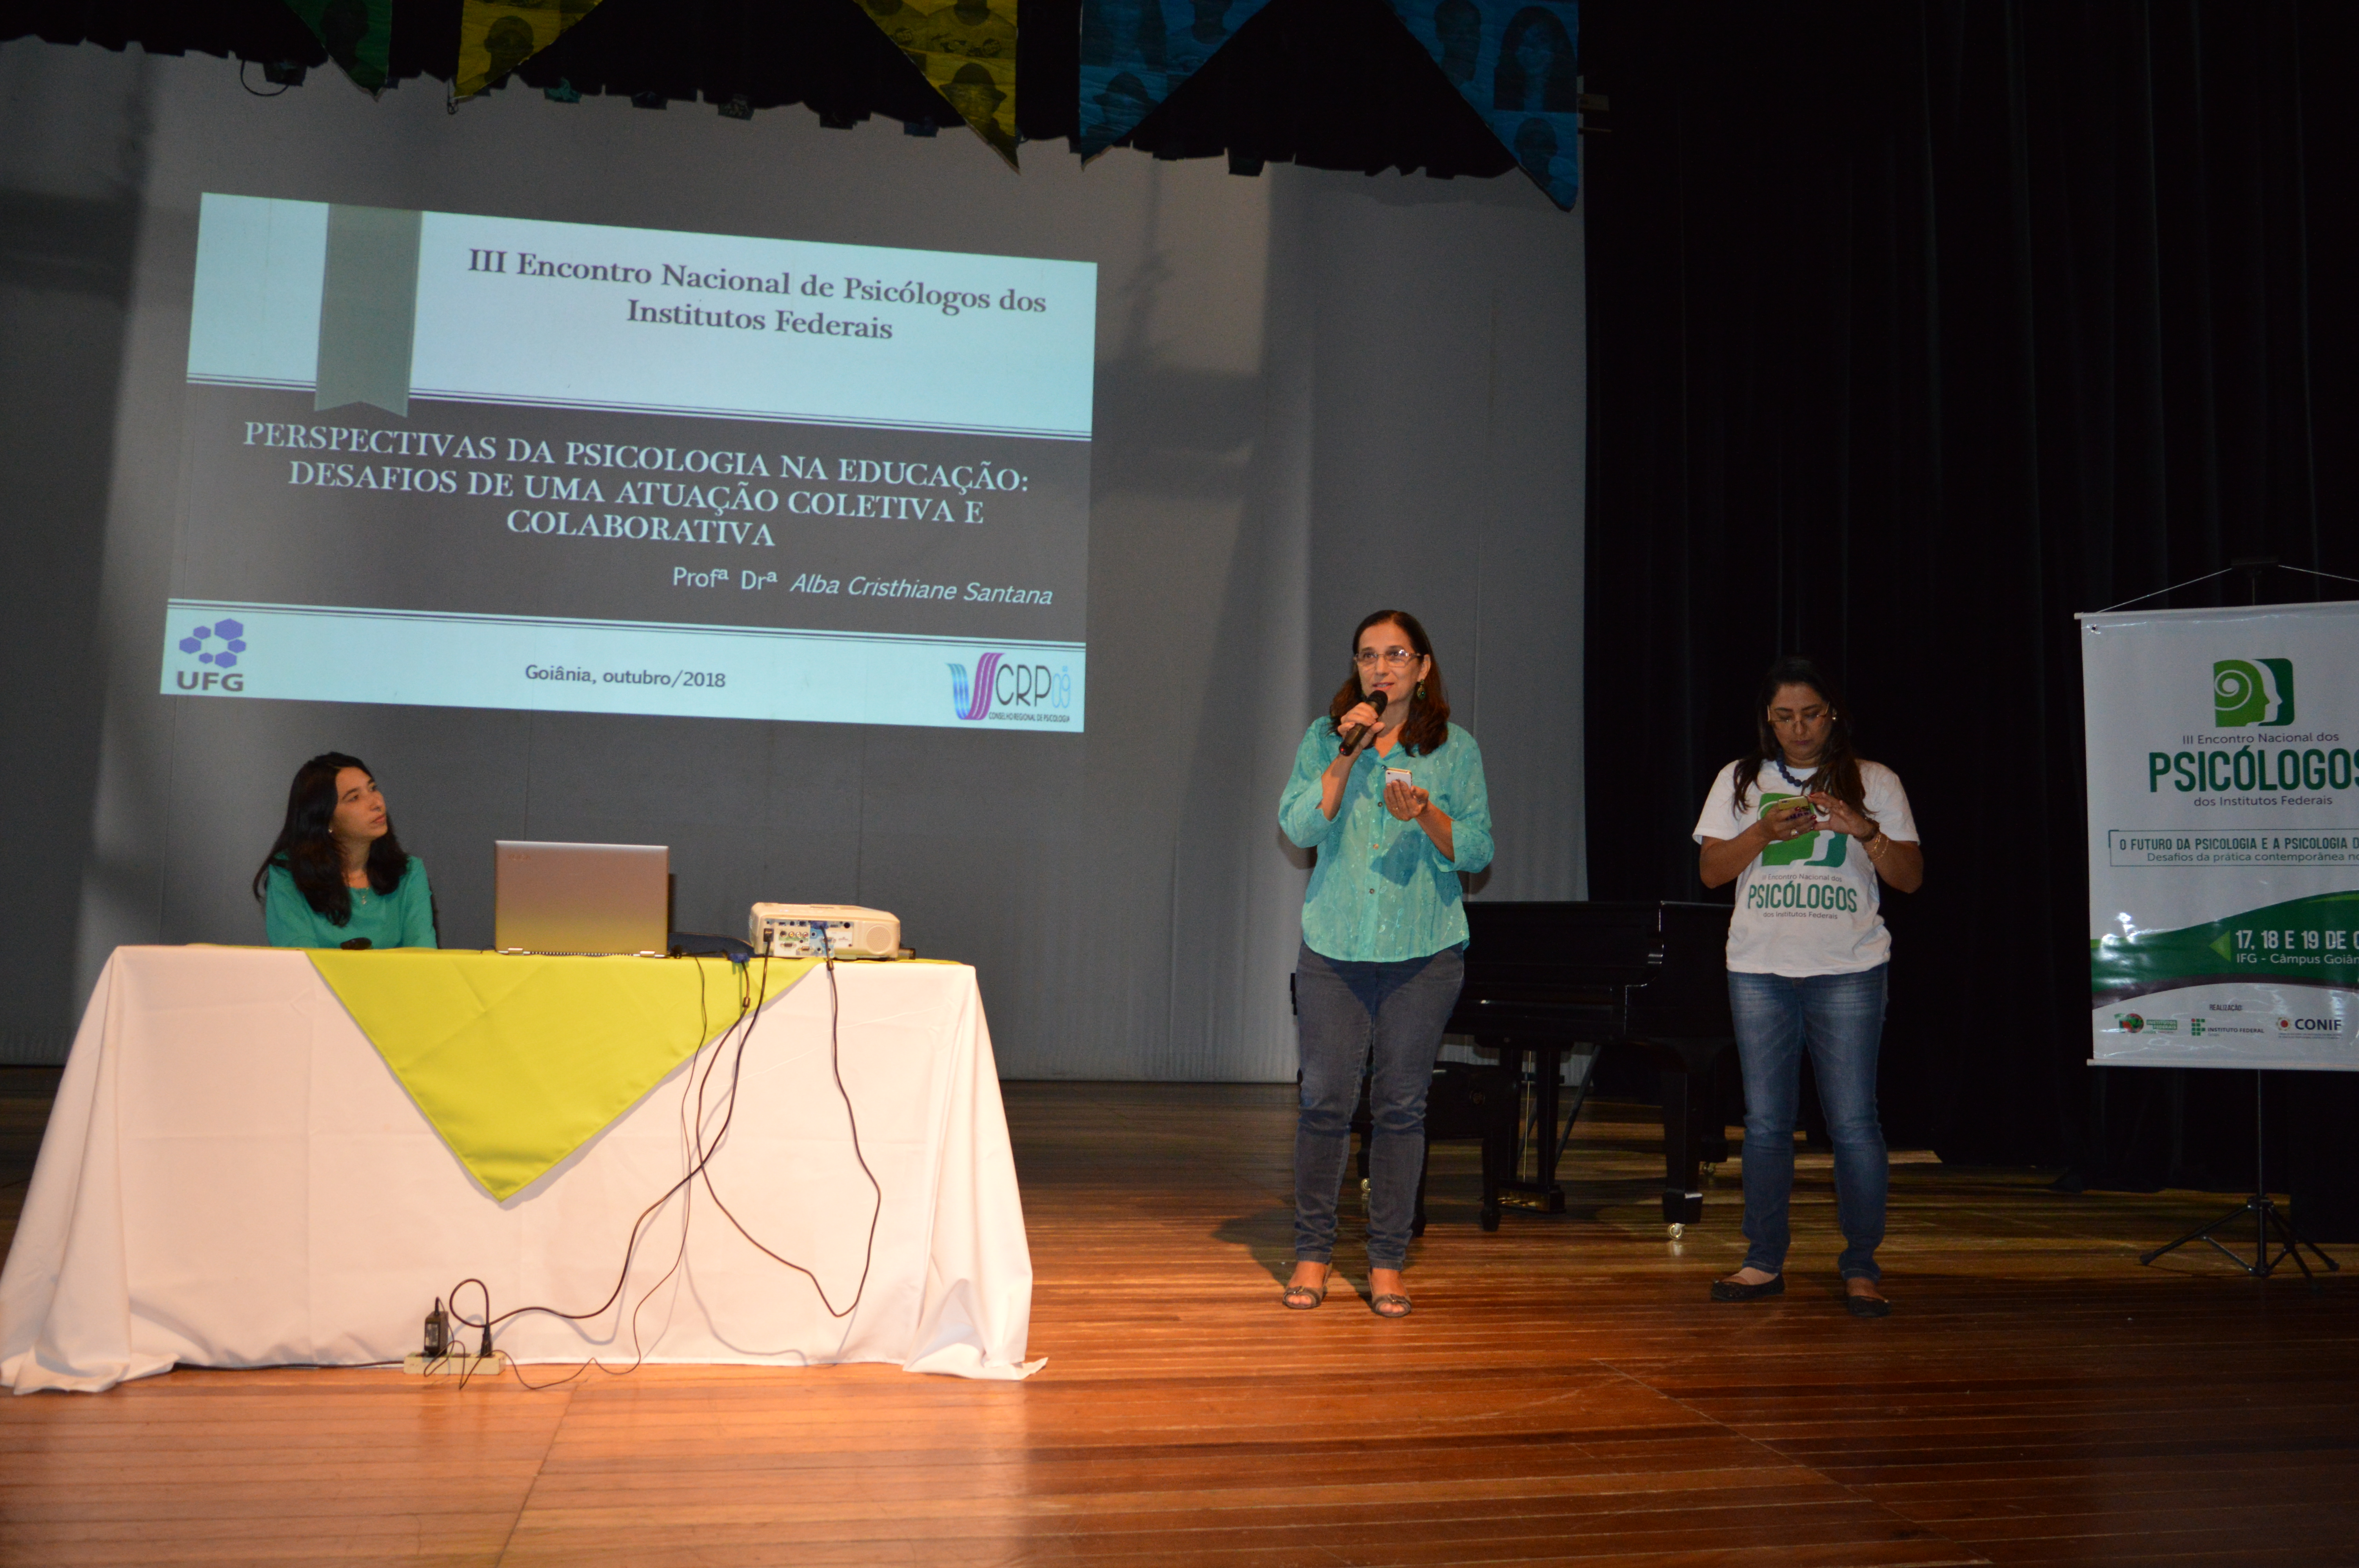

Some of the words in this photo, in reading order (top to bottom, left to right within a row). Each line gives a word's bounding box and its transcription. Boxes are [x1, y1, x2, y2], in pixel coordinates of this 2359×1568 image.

[469, 249, 507, 273] III
[517, 252, 652, 284] Encontro
[662, 264, 791, 295] Nacional
[801, 275, 834, 298] de
[844, 278, 990, 316] Psicólogos
[999, 289, 1046, 312] dos
[627, 299, 766, 330] Institutos
[775, 310, 893, 339] Federais
[244, 421, 497, 460] PERSPECTIVAS
[506, 438, 556, 464] DA
[565, 441, 771, 477] PSICOLOGIA
[780, 455, 828, 480] NA
[838, 459, 1029, 495] EDUCAÇÃO:
[289, 461, 457, 493] DESAFIOS
[467, 472, 513, 497] DE
[525, 475, 605, 502] UMA
[615, 481, 779, 516] ATUAÇÃO
[788, 491, 954, 522] COLETIVA
[965, 501, 983, 523] E
[507, 510, 775, 546] COLABORATIVA
[790, 573, 840, 594] Alba
[848, 576, 957, 600] Cristhiane
[963, 582, 1053, 604] Santana
[176, 670, 244, 692] UFG
[525, 664, 596, 684] Goiânia,
[603, 670, 726, 688] outubro/2018
[2183, 735, 2193, 744] III
[2198, 734, 2254, 744] Encontro
[2258, 732, 2313, 742] Nacional
[2317, 732, 2339, 741] dos
[2149, 745, 2359, 792] PSICÓLOGO
[2194, 797, 2216, 806] dos
[2220, 796, 2277, 806] Institutos
[2281, 795, 2333, 805] Federais
[2119, 839, 2126, 850] O
[2130, 838, 2172, 850] FUTURO
[2177, 838, 2191, 850] DA
[2195, 838, 2257, 850] PSICOLOGIA
[2262, 838, 2268, 849] E
[2273, 838, 2280, 849] A
[2284, 837, 2348, 849] PSICOLOGIA
[2147, 853, 2193, 861] Desafios
[2197, 853, 2210, 861] da
[2214, 853, 2251, 862] prática
[2255, 852, 2344, 862] contemporânea
[1748, 880, 1857, 913] PSICÓLOGOS
[2235, 930, 2255, 950] 17,
[2261, 930, 2279, 949] 18
[2285, 931, 2295, 949] E
[2301, 931, 2319, 949] 19
[2325, 931, 2347, 949] DE
[2237, 953, 2257, 963] IFG
[2270, 954, 2320, 965] Câmpus
[2295, 1018, 2342, 1031] CONIF
